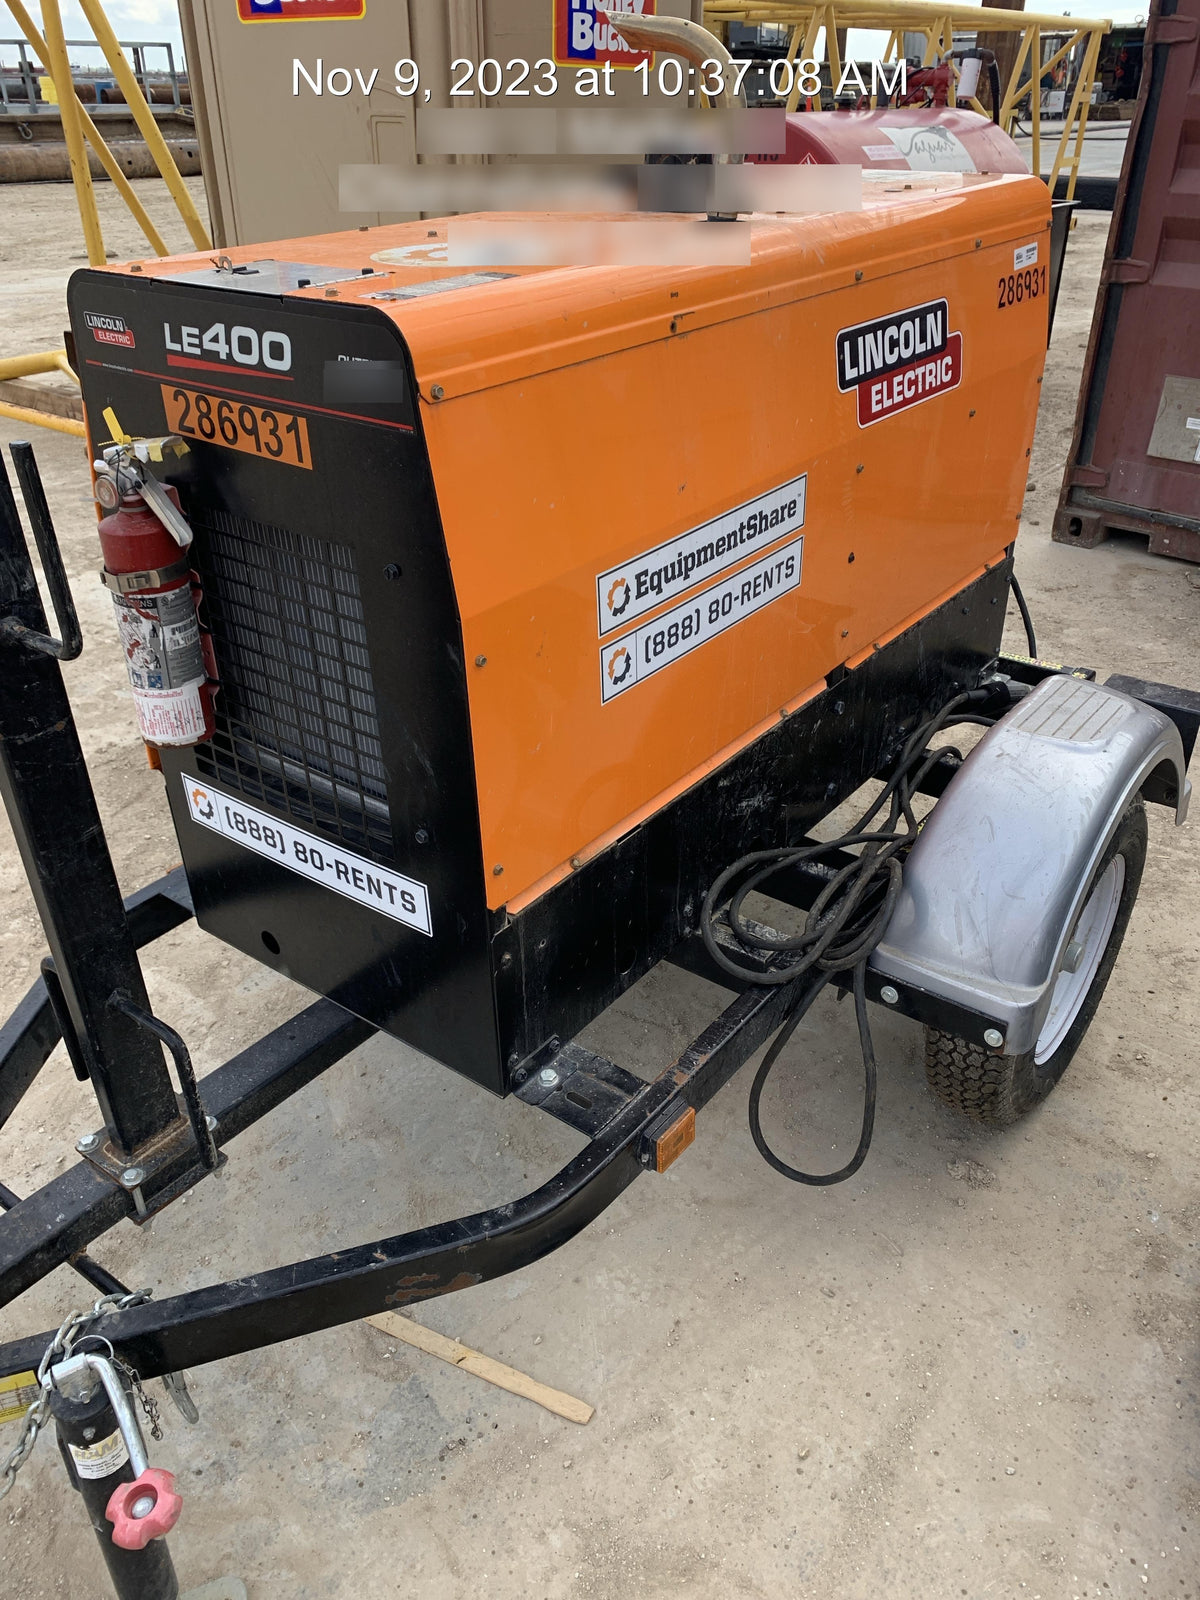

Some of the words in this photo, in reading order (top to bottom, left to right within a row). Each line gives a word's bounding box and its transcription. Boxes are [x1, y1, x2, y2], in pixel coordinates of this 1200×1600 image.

[998, 265, 1046, 309] 286931
[86, 314, 124, 332] LINCOLN
[98, 330, 131, 345] ELECTRIC
[163, 322, 292, 372] LE400
[843, 310, 943, 381] LINCOLN
[871, 355, 952, 414] ELECTRIC
[173, 389, 304, 464] 286931
[634, 499, 797, 601] EquipmentShare
[644, 608, 701, 664] (888)
[708, 555, 796, 625] 80-RENTS
[224, 805, 286, 855] (888)
[293, 840, 417, 915] 80-RENTS
